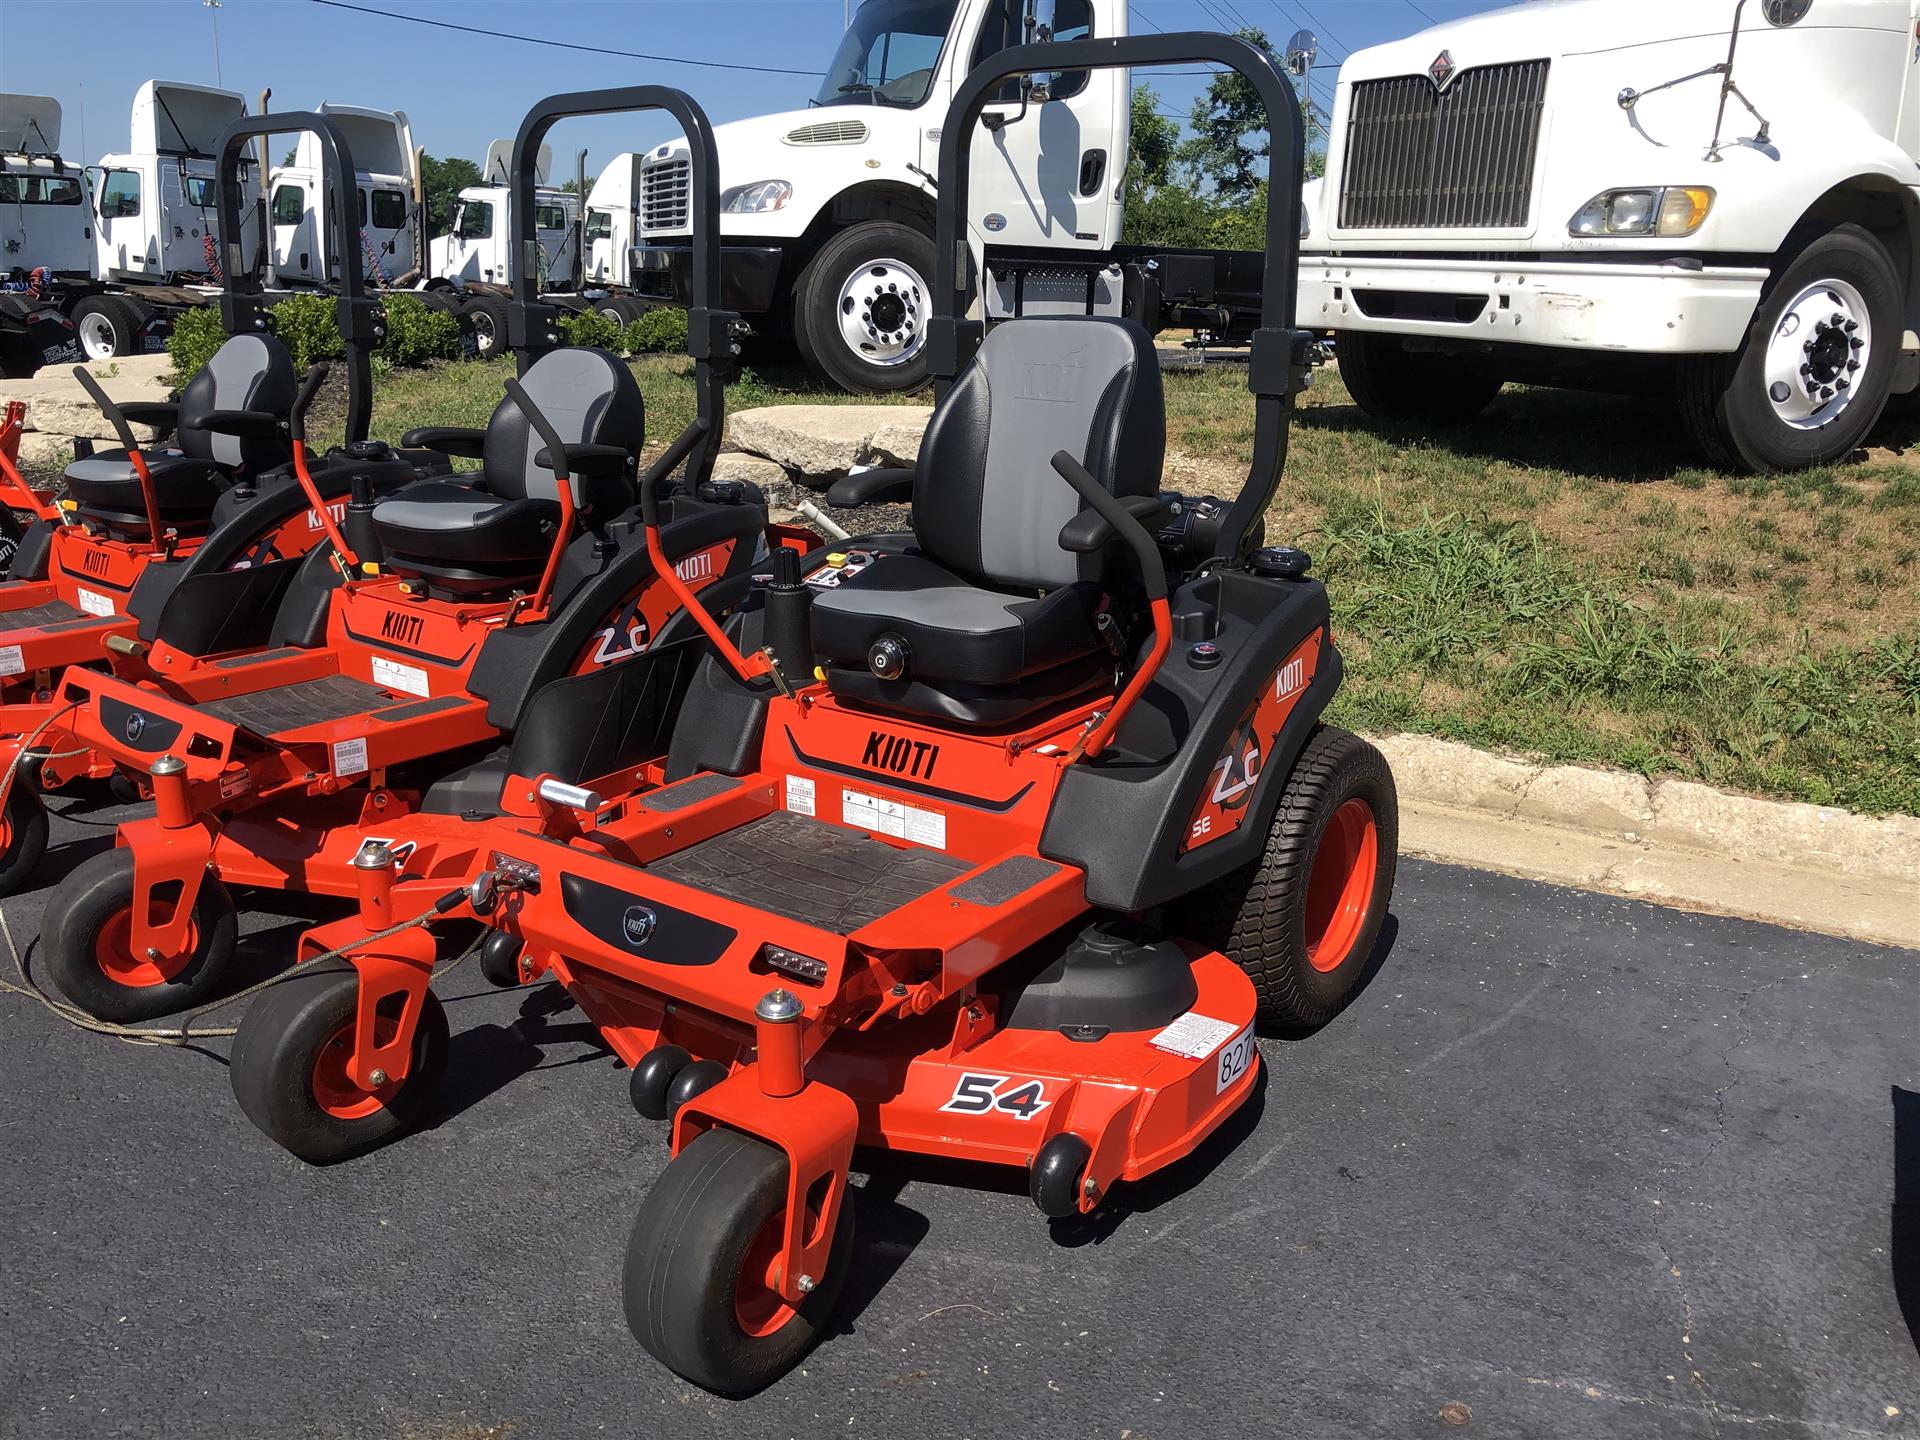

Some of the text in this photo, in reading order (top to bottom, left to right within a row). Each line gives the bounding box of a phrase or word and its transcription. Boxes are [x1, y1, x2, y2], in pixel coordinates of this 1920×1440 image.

[308, 504, 345, 529] KTI
[83, 549, 110, 577] KIOTI
[676, 553, 712, 581] KIOTI
[381, 610, 424, 645] KIOTI
[1276, 658, 1303, 698] KIOTI
[861, 731, 940, 780] KIOTI
[1192, 815, 1211, 838] SE
[627, 918, 646, 935] KIOTI
[938, 1072, 1051, 1120] 54
